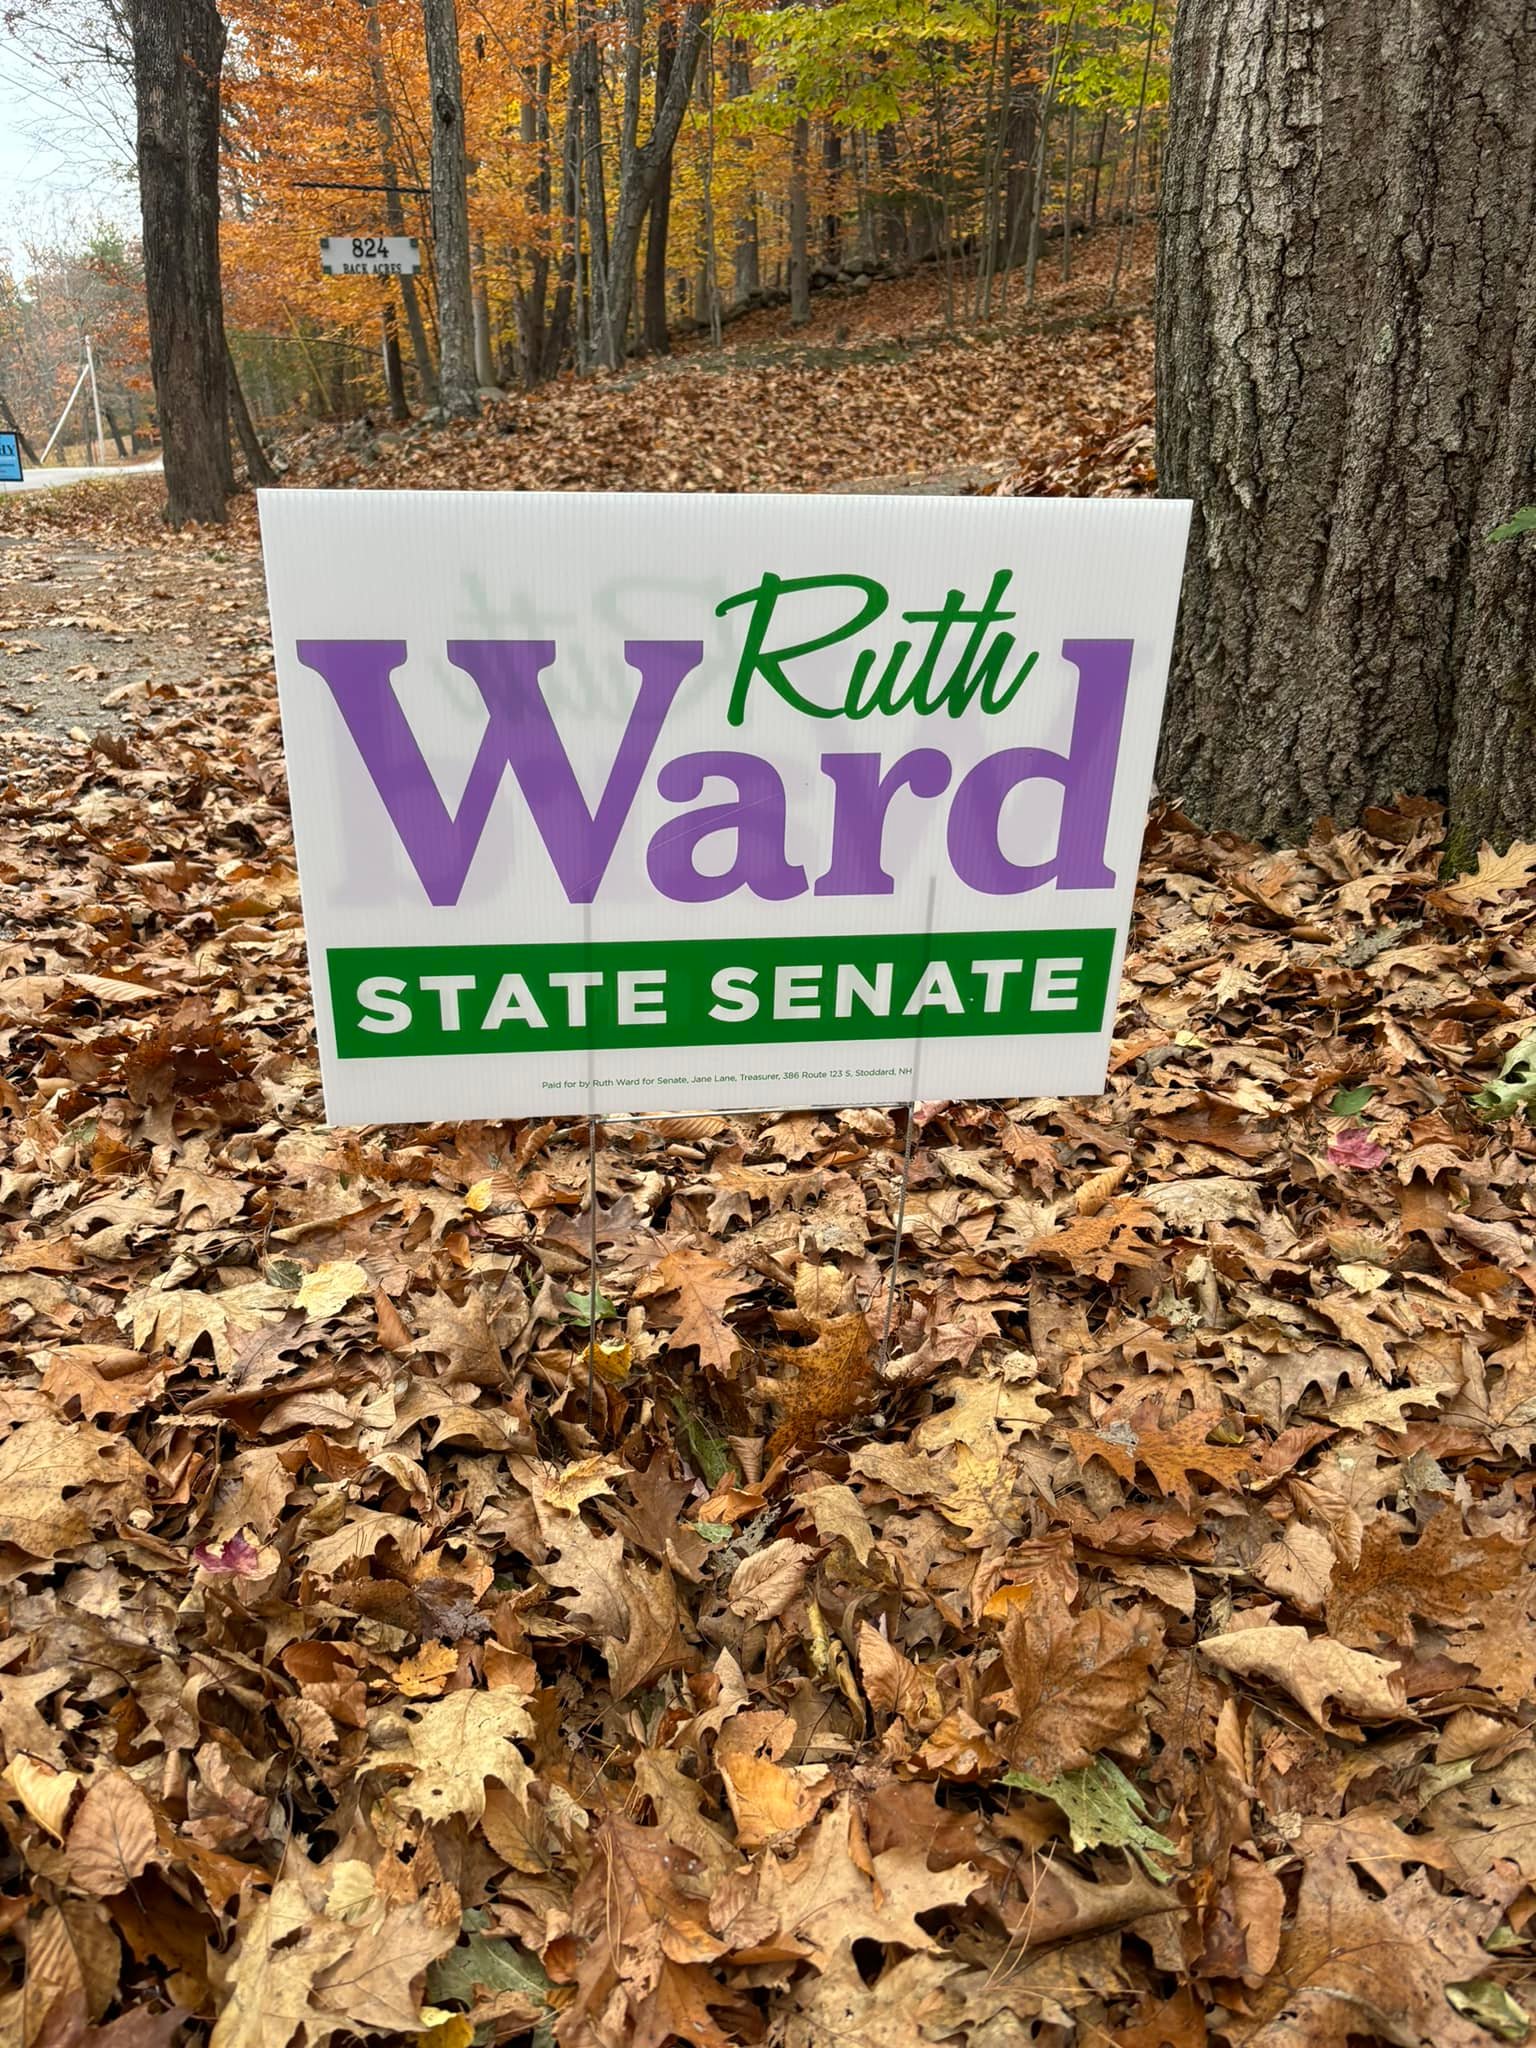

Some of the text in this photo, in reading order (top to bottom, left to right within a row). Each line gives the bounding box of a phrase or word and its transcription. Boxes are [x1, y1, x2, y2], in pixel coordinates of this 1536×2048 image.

[343, 263, 402, 274] BACK ACRES
[352, 237, 389, 258] 824
[715, 569, 1039, 726] Ruth
[297, 638, 1134, 906] Ward
[356, 957, 1083, 1035] STATE SENATE
[542, 1080, 561, 1089] Paid
[564, 1080, 576, 1089] for
[579, 1080, 590, 1090] by
[592, 1079, 614, 1087] Ruth
[616, 1078, 640, 1086] Ward
[642, 1077, 655, 1086] for
[657, 1076, 689, 1085] Senate,
[691, 1075, 712, 1084] Jane
[714, 1074, 737, 1083] Lane,
[740, 1073, 780, 1082] Treasurer,
[783, 1071, 800, 1080] 386
[802, 1071, 827, 1079] Route
[829, 1070, 843, 1078] 123
[855, 1068, 897, 1077] Stoddard,
[899, 1067, 913, 1075] NH
